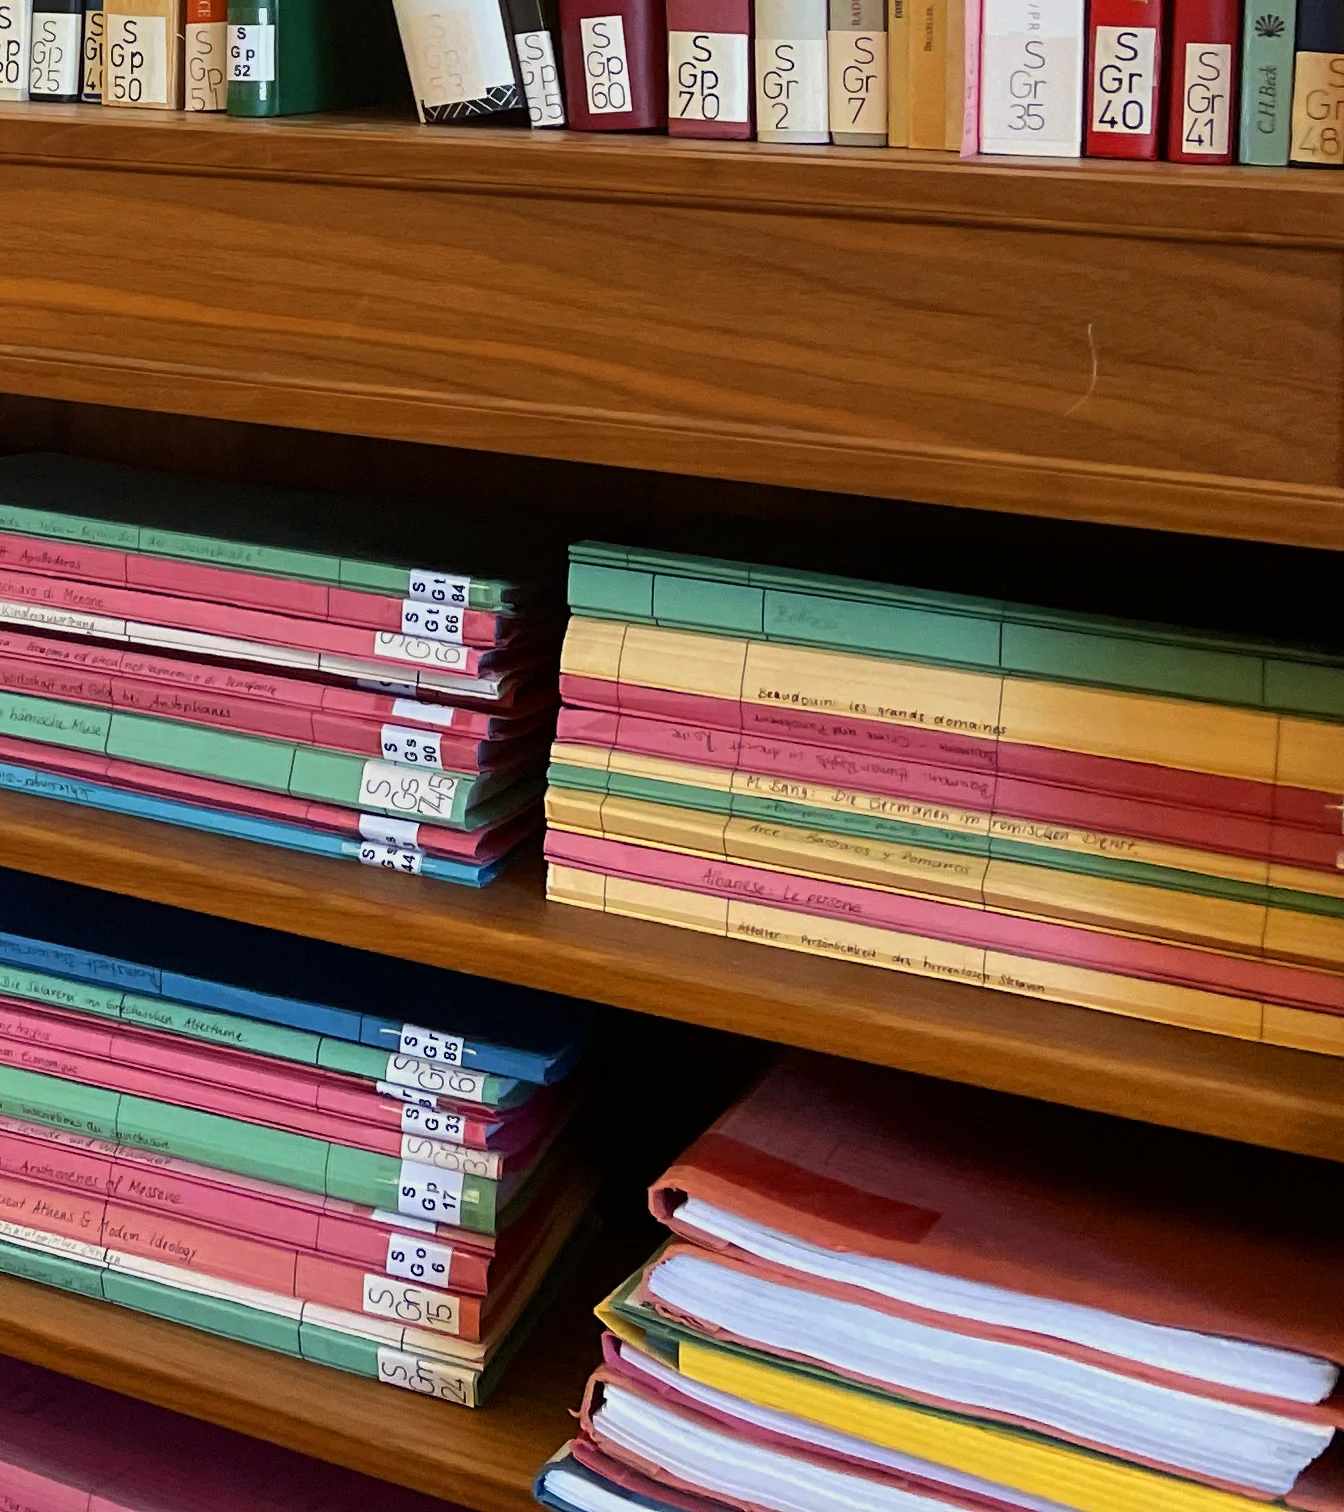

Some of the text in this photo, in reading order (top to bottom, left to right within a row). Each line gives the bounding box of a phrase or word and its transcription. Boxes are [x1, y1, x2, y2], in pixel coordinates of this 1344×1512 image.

[592, 22, 611, 49] S
[1114, 31, 1138, 60] S
[586, 50, 624, 82] Gp
[1098, 64, 1141, 94] Gr
[591, 82, 626, 109] 60
[1098, 100, 1144, 130] 40
